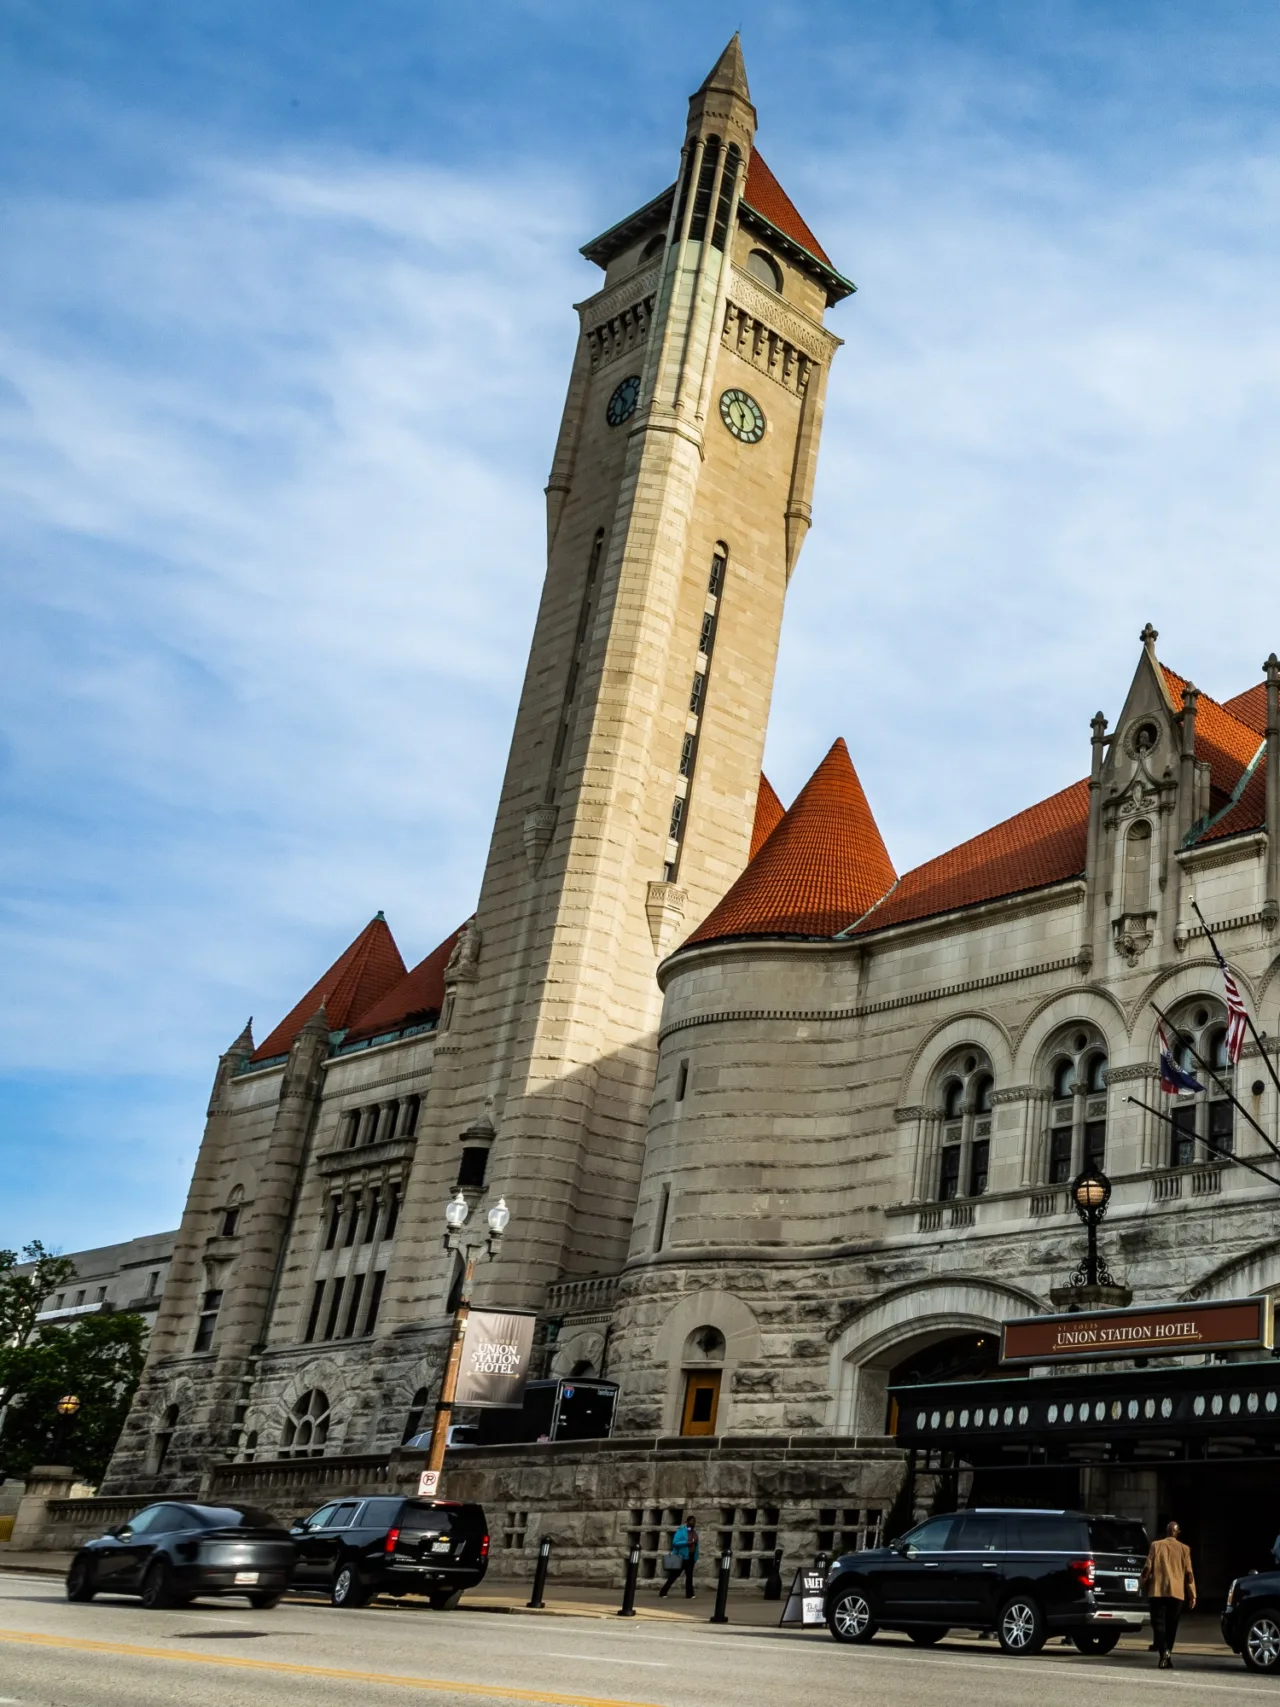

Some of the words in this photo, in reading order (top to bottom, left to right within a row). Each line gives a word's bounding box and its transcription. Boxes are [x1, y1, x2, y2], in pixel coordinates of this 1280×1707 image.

[1057, 1330, 1098, 1344] UNION
[1100, 1325, 1152, 1341] STATION
[1155, 1322, 1198, 1337] HOTEL
[1073, 1323, 1098, 1331] LOUIS
[478, 1343, 518, 1355] UNION
[471, 1351, 521, 1365] STATION
[474, 1362, 514, 1374] HOTEL
[803, 1577, 824, 1589] VALET
